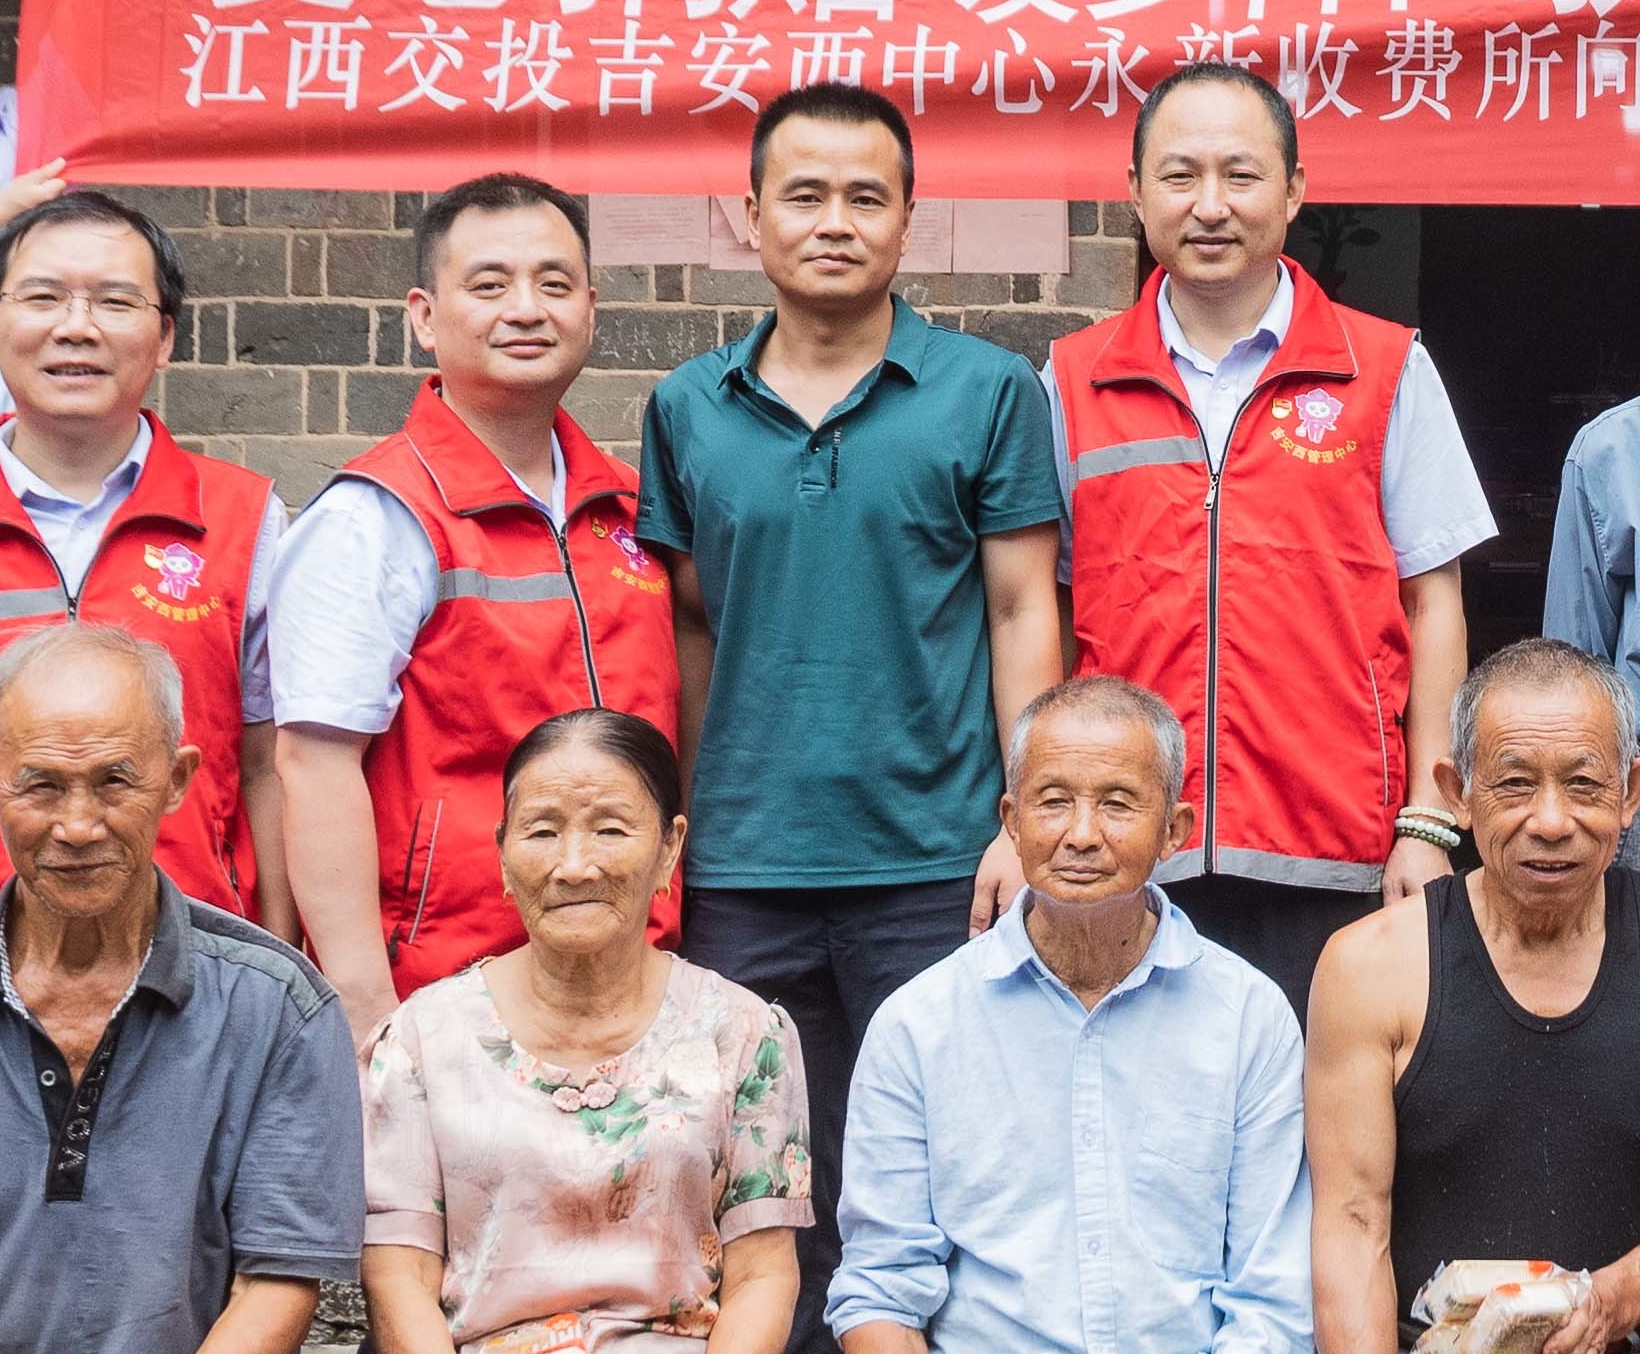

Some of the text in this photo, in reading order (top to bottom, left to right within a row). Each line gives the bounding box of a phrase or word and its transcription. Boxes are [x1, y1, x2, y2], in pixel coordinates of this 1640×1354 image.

[1270, 426, 1358, 465] 吉安西管理中心
